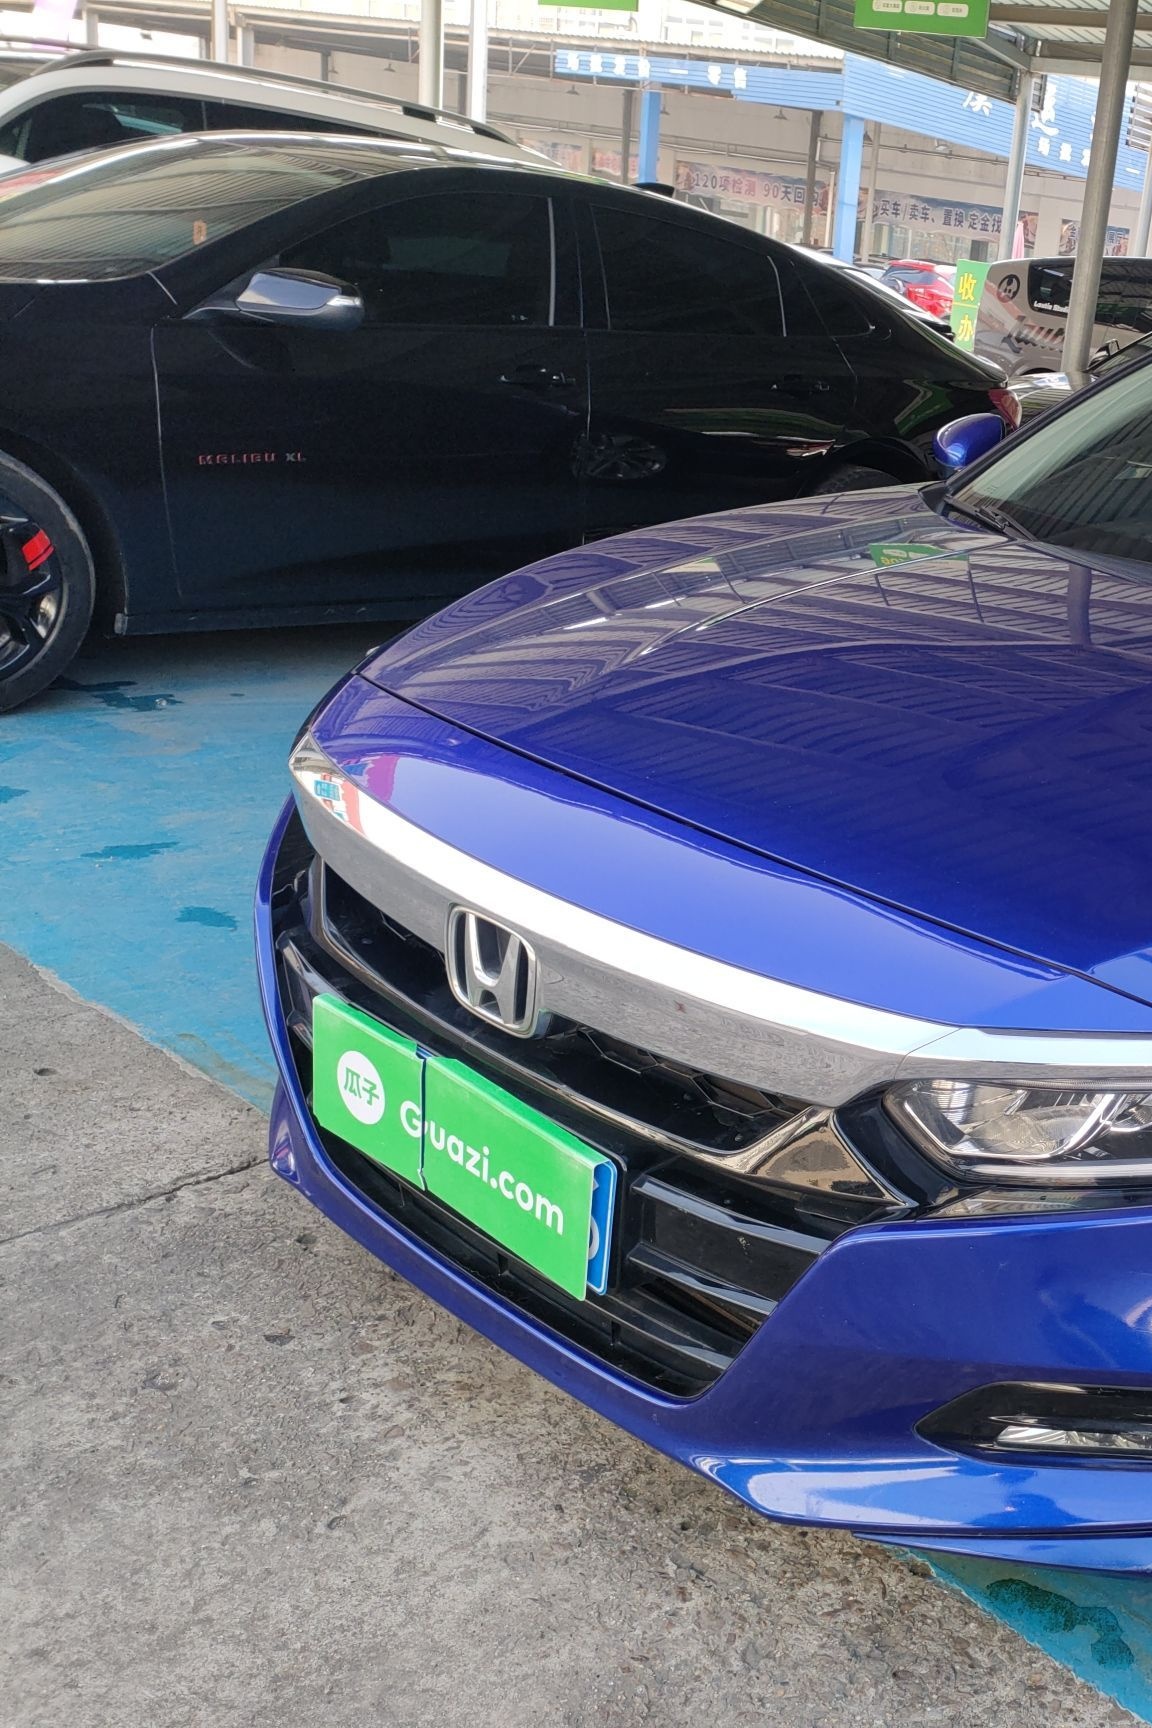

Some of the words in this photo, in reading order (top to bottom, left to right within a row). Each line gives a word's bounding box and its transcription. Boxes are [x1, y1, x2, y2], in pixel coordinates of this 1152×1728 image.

[958, 272, 977, 301] 收
[198, 452, 275, 465] MALIBU
[285, 452, 306, 462] XL
[343, 1066, 379, 1106] 瓜子
[399, 1099, 564, 1236] Guazi.com
